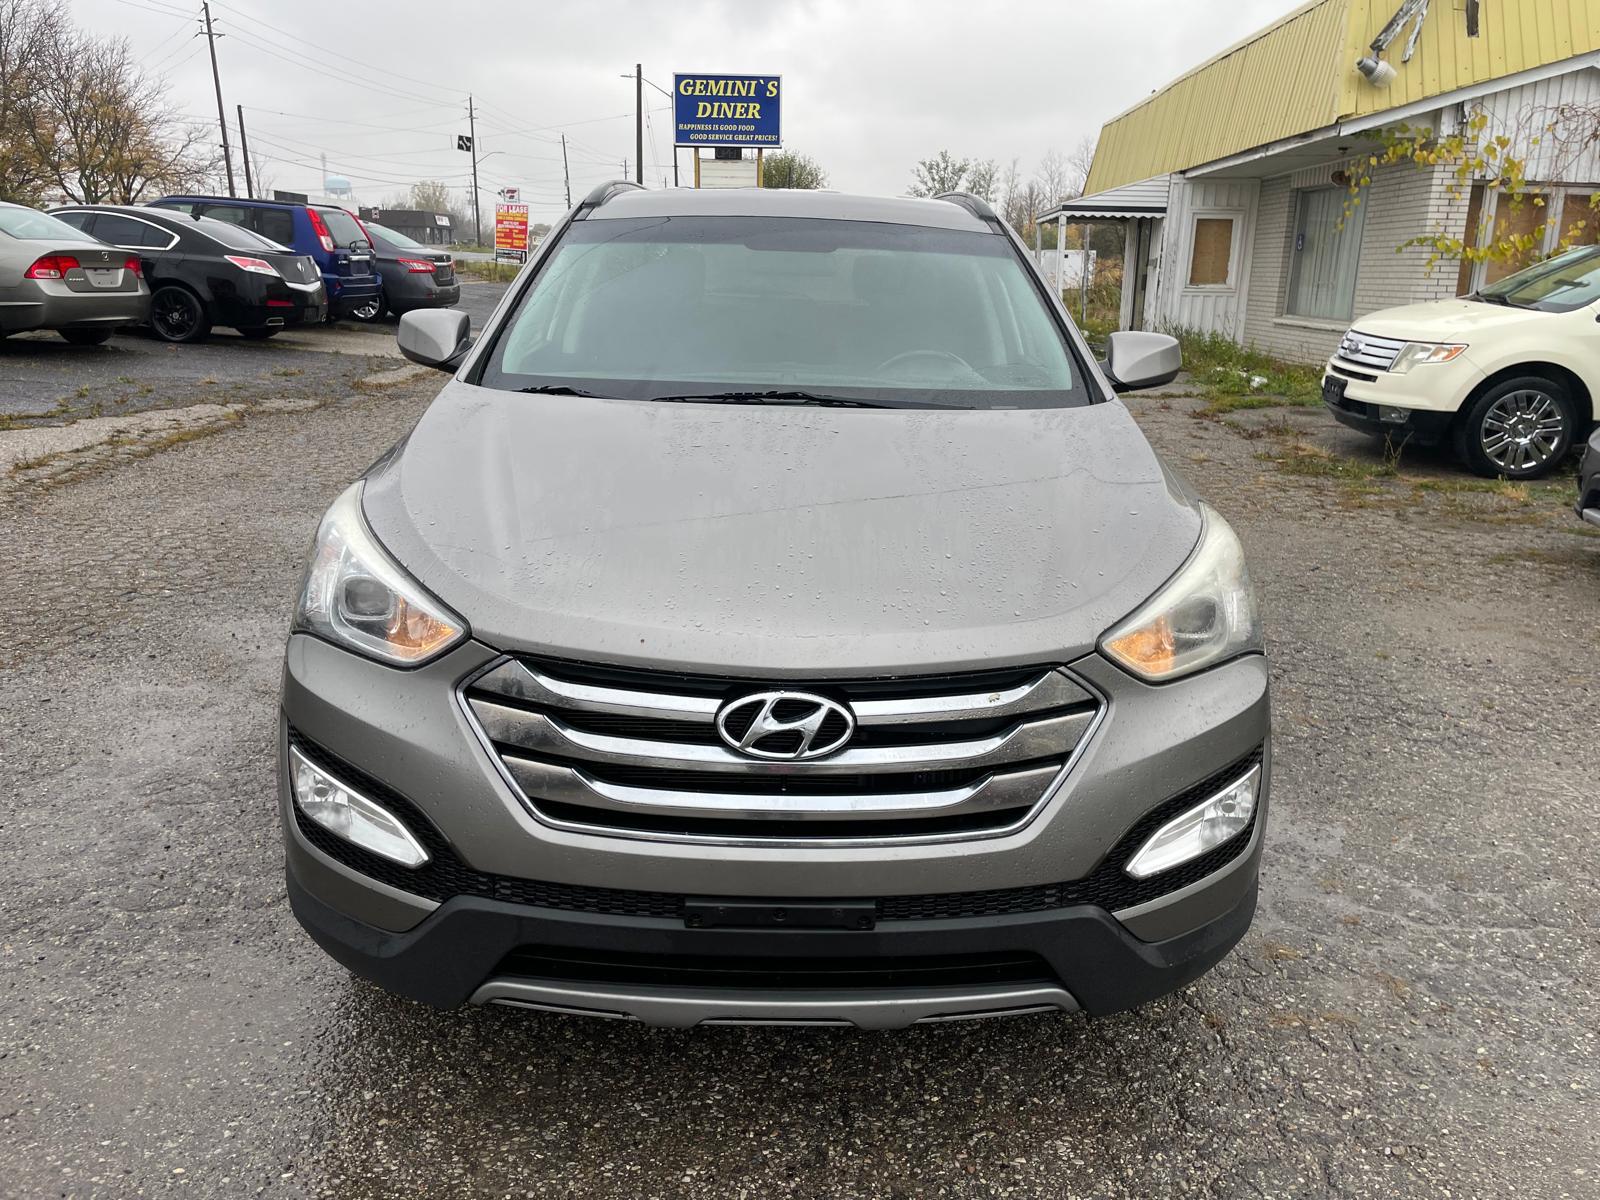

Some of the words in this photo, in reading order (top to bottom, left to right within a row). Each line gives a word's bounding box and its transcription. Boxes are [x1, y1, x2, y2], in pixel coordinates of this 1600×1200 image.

[696, 102, 761, 119] DINER
[678, 123, 712, 131] HAPPINESS
[708, 133, 733, 141] SERVICE
[496, 205, 508, 213] FOR
[509, 205, 528, 213] LEASE
